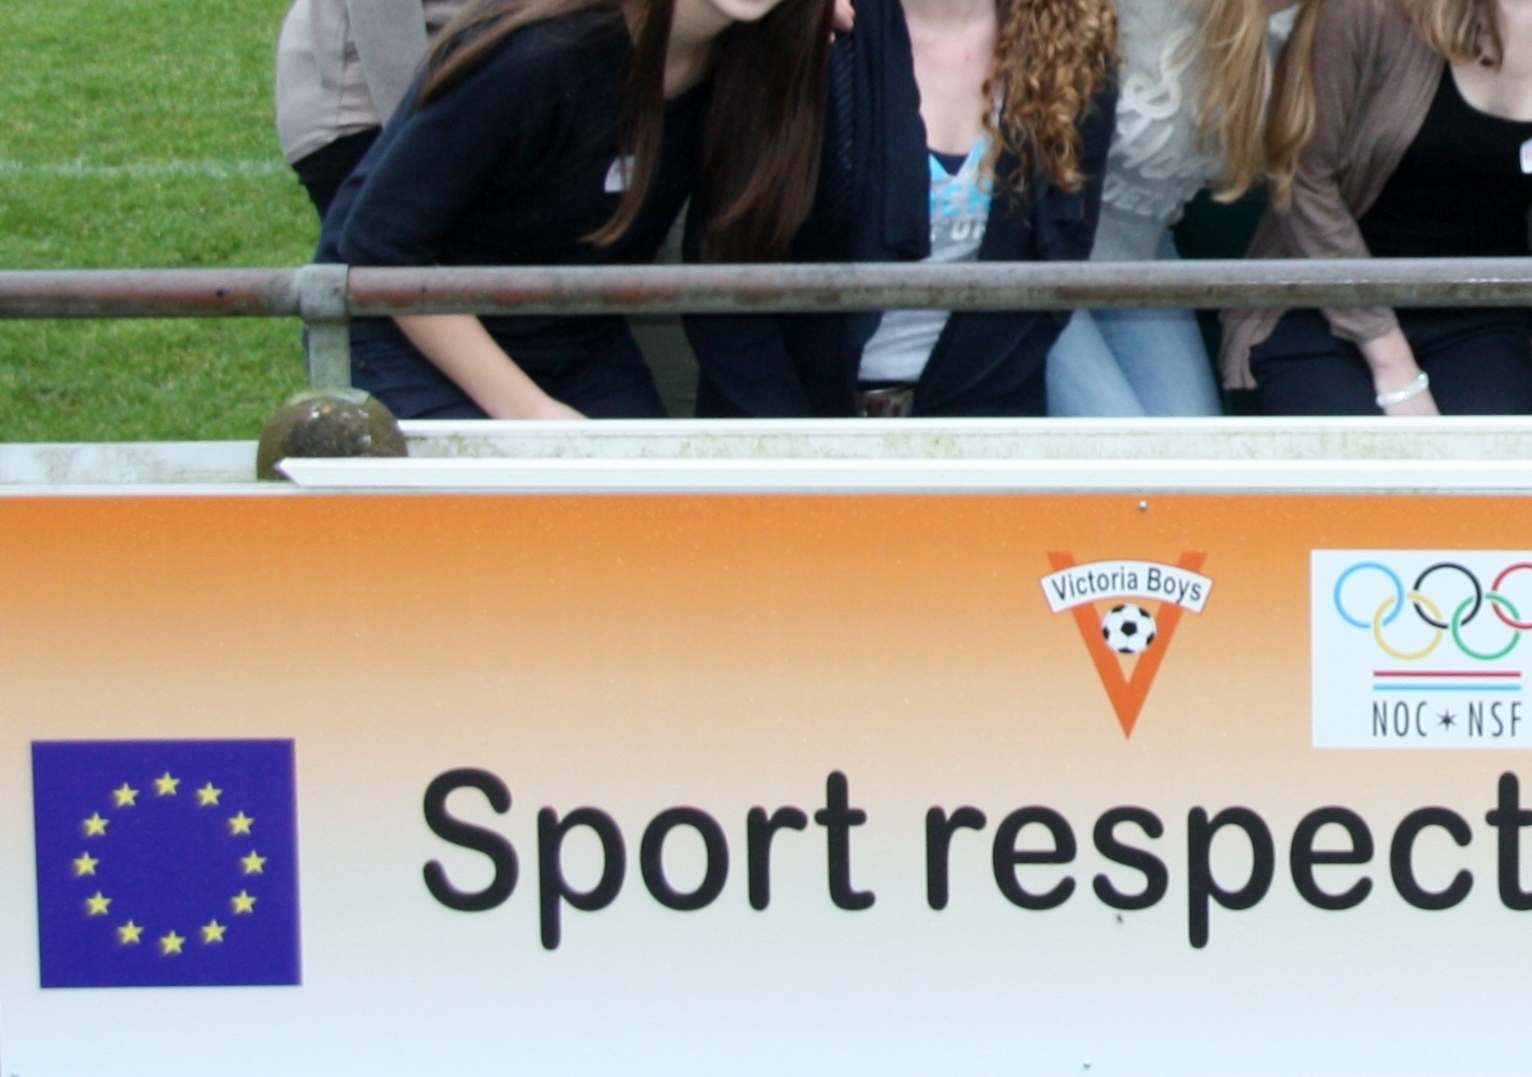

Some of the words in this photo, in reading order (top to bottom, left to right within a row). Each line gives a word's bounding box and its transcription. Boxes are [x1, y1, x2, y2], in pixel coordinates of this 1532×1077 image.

[1051, 565, 1138, 601] Victoria
[1147, 567, 1203, 605] Boys
[1372, 701, 1428, 737] NOC
[1469, 701, 1522, 738] NSF
[423, 768, 875, 951] Sport
